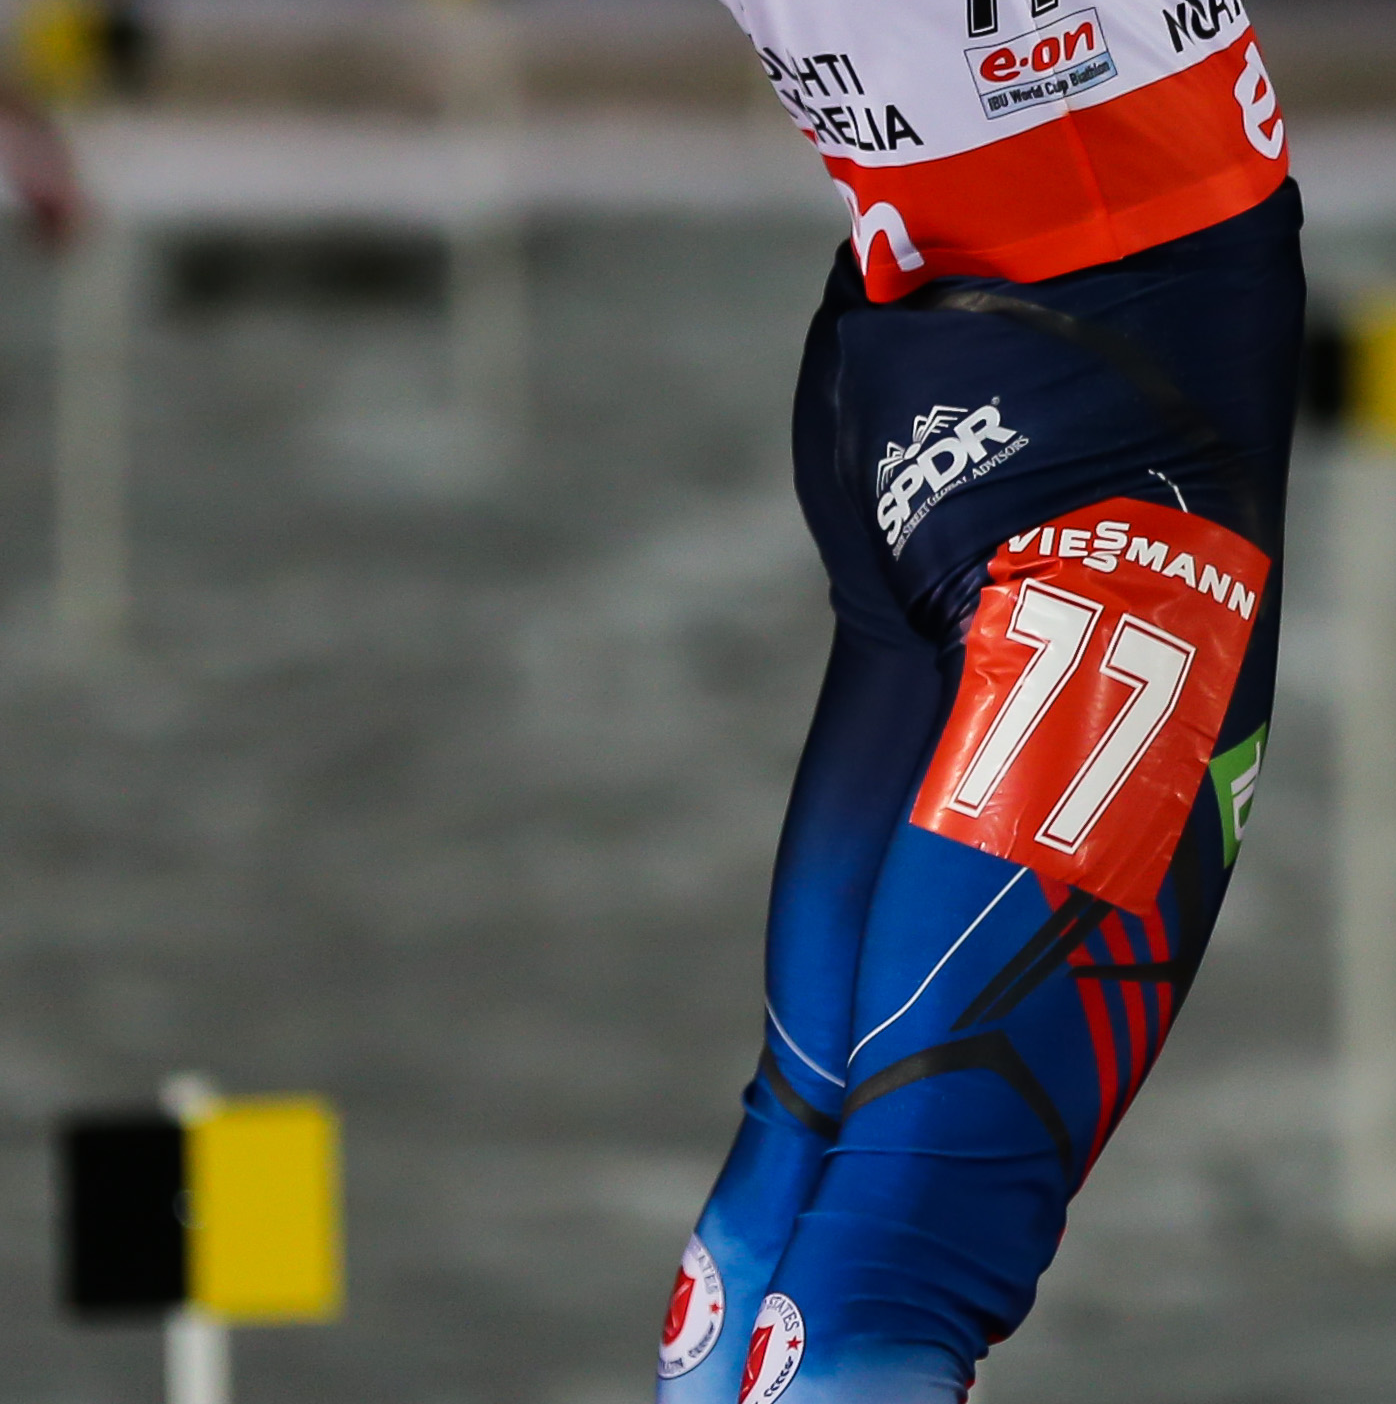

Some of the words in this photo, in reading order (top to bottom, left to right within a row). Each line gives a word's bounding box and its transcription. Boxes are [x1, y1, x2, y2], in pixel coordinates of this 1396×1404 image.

[987, 95, 1008, 111] IBU
[1009, 85, 1044, 104] World
[1045, 78, 1069, 96] Cup
[1069, 61, 1111, 86] Biathlon
[877, 404, 1018, 545] SPDR
[971, 434, 1030, 480] ADVISORS
[945, 577, 1198, 856] 77
